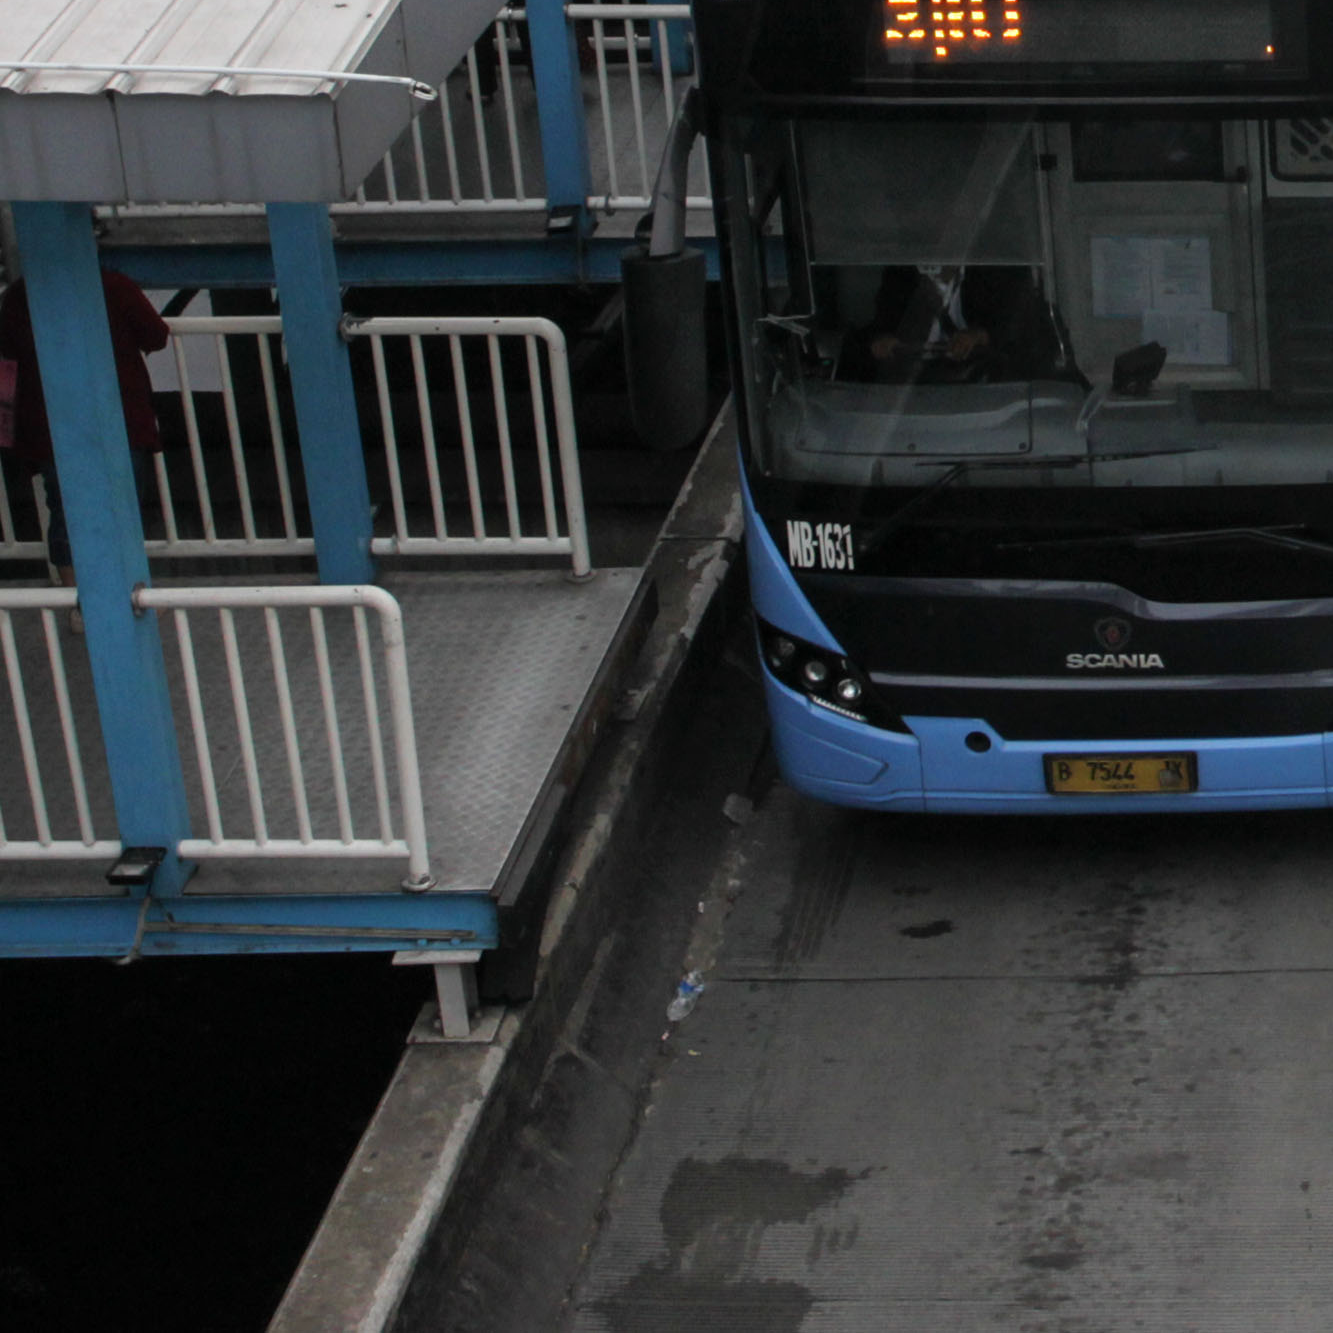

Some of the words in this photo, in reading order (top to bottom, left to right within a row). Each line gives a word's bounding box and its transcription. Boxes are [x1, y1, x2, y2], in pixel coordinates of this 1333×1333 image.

[786, 519, 855, 570] MB-1631
[1066, 653, 1165, 668] SCANIA
[1057, 762, 1072, 780] B
